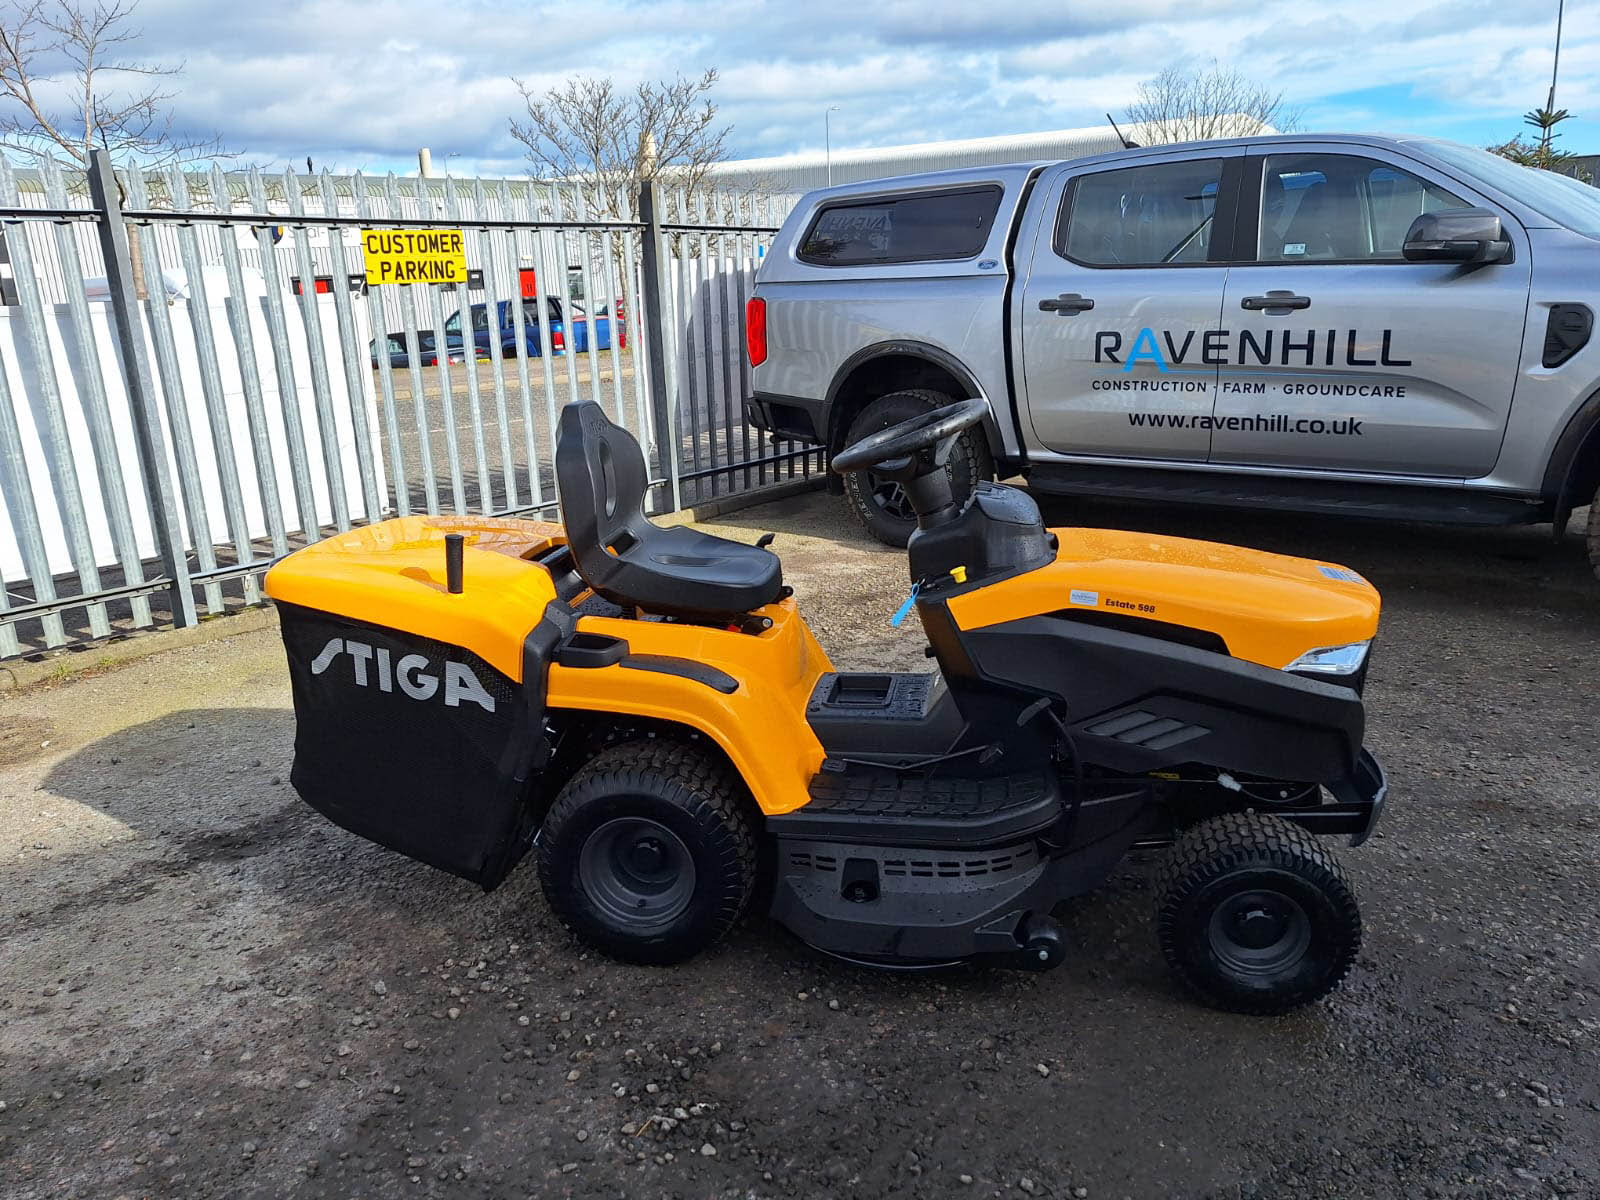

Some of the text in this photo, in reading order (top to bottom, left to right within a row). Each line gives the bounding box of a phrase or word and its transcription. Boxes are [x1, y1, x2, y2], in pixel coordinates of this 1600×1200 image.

[367, 234, 461, 254] CUSTOMER
[380, 260, 456, 280] PARKING
[1094, 327, 1412, 373] RAVENHILL
[1092, 380, 1407, 398] CONSTRUCTION FARM GROUNDCARE
[1128, 413, 1363, 436] www.ravenhill.co.uk
[1105, 598, 1136, 610] Estate
[1138, 603, 1156, 613] 598
[311, 637, 496, 713] STIGA
